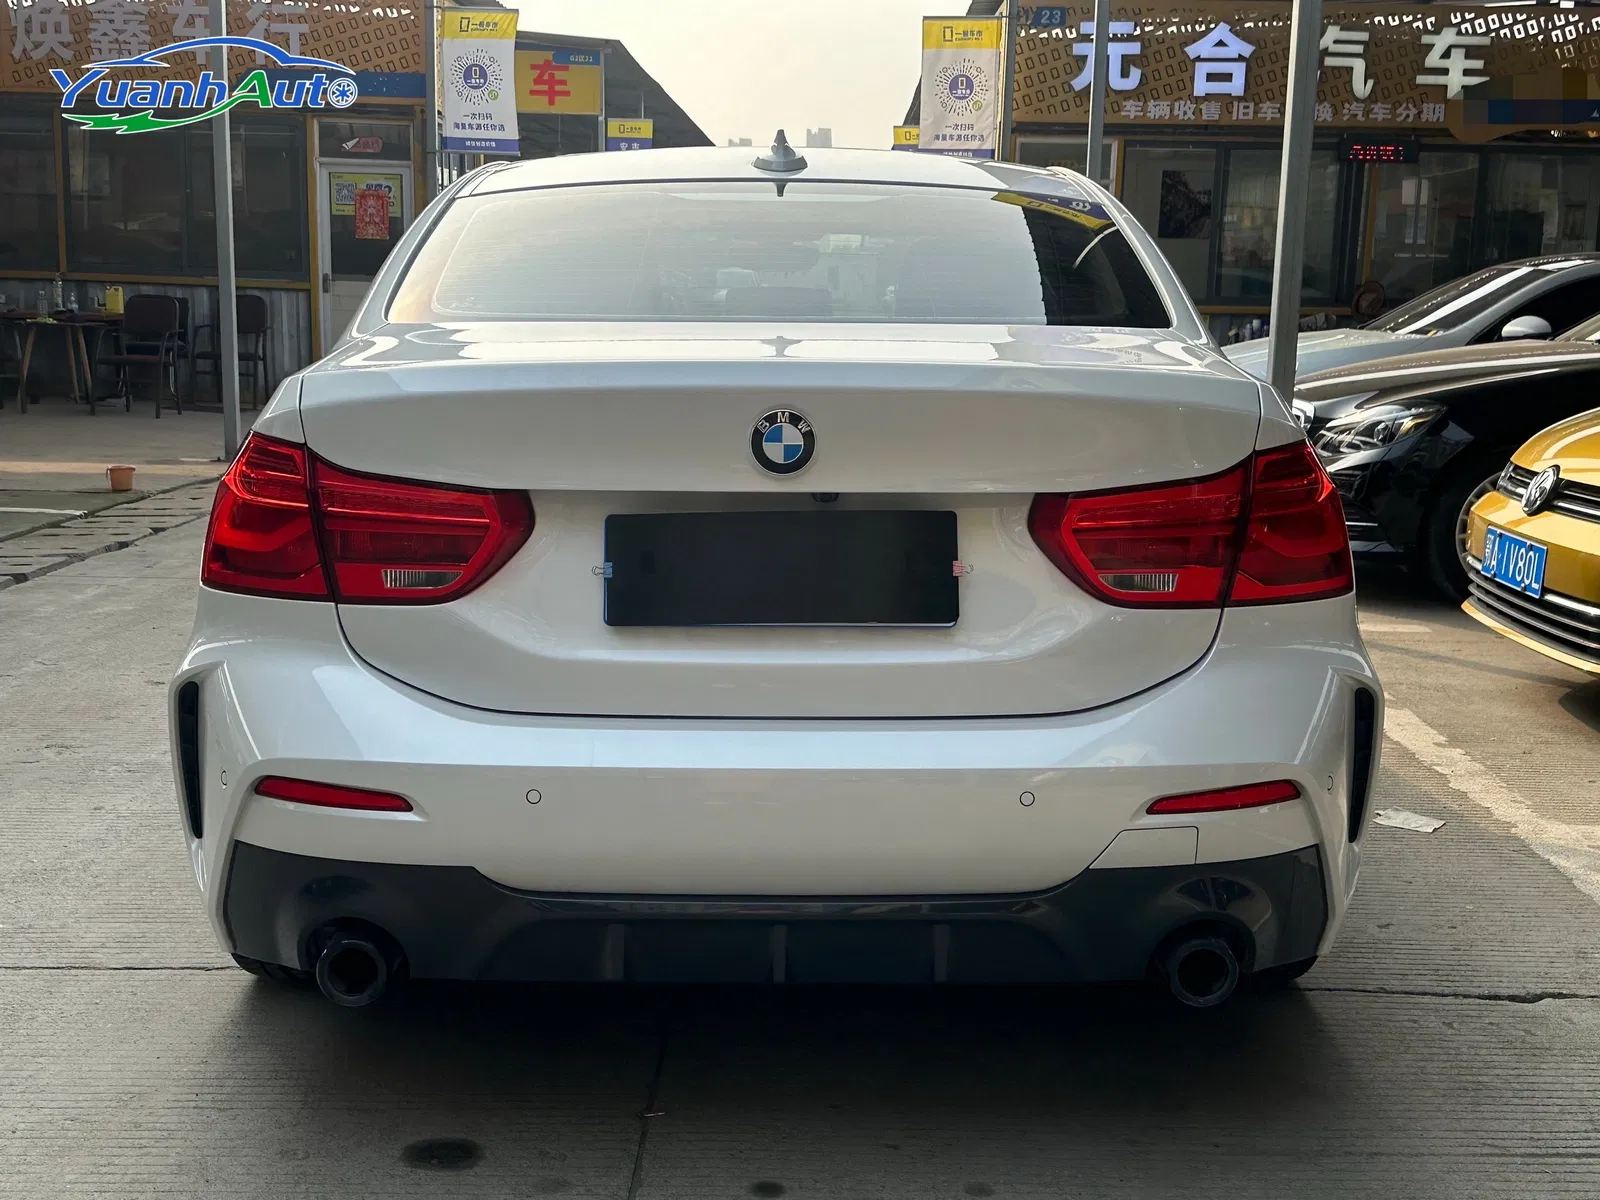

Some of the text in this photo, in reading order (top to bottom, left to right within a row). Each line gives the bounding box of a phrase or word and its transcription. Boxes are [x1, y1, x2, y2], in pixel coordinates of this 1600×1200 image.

[1040, 10, 1062, 24] 23
[528, 58, 571, 106] 车
[463, 112, 493, 121] 一次扫码
[1120, 100, 1446, 122] 车辆收售 旧车换 汽车分期
[945, 123, 975, 131] 一次扫码
[756, 411, 811, 434] BMW
